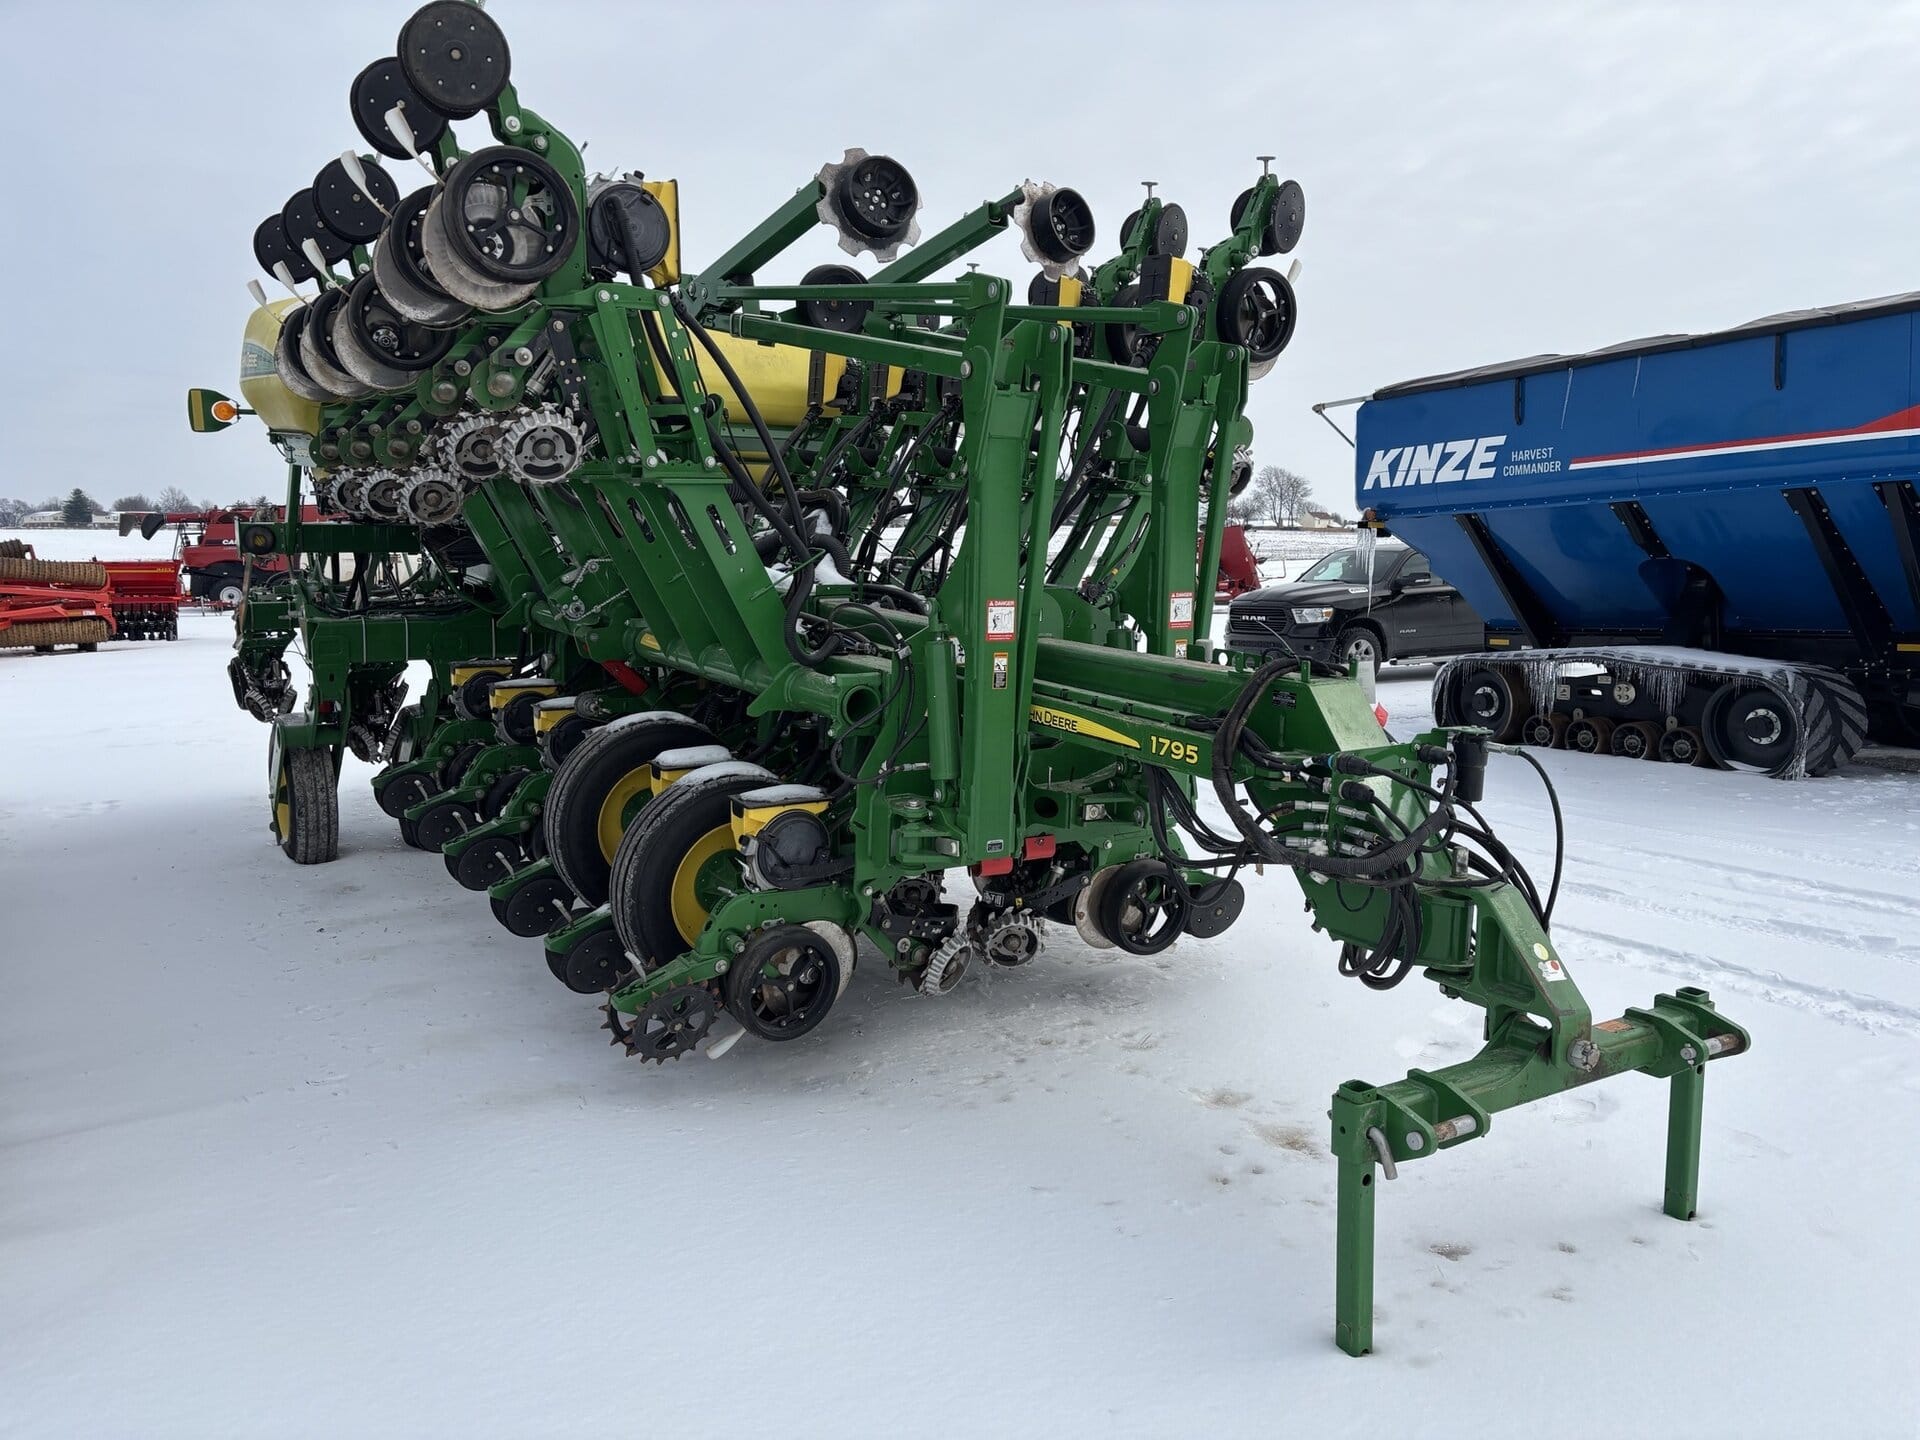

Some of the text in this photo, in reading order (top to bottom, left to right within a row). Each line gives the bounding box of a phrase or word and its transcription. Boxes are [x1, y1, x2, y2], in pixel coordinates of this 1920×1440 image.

[1363, 435, 1507, 490] KINZE
[1511, 447, 1554, 462] HARVEST
[1503, 461, 1562, 477] COMMANDER
[1045, 710, 1078, 731] DEERE
[1150, 735, 1199, 764] 1795
